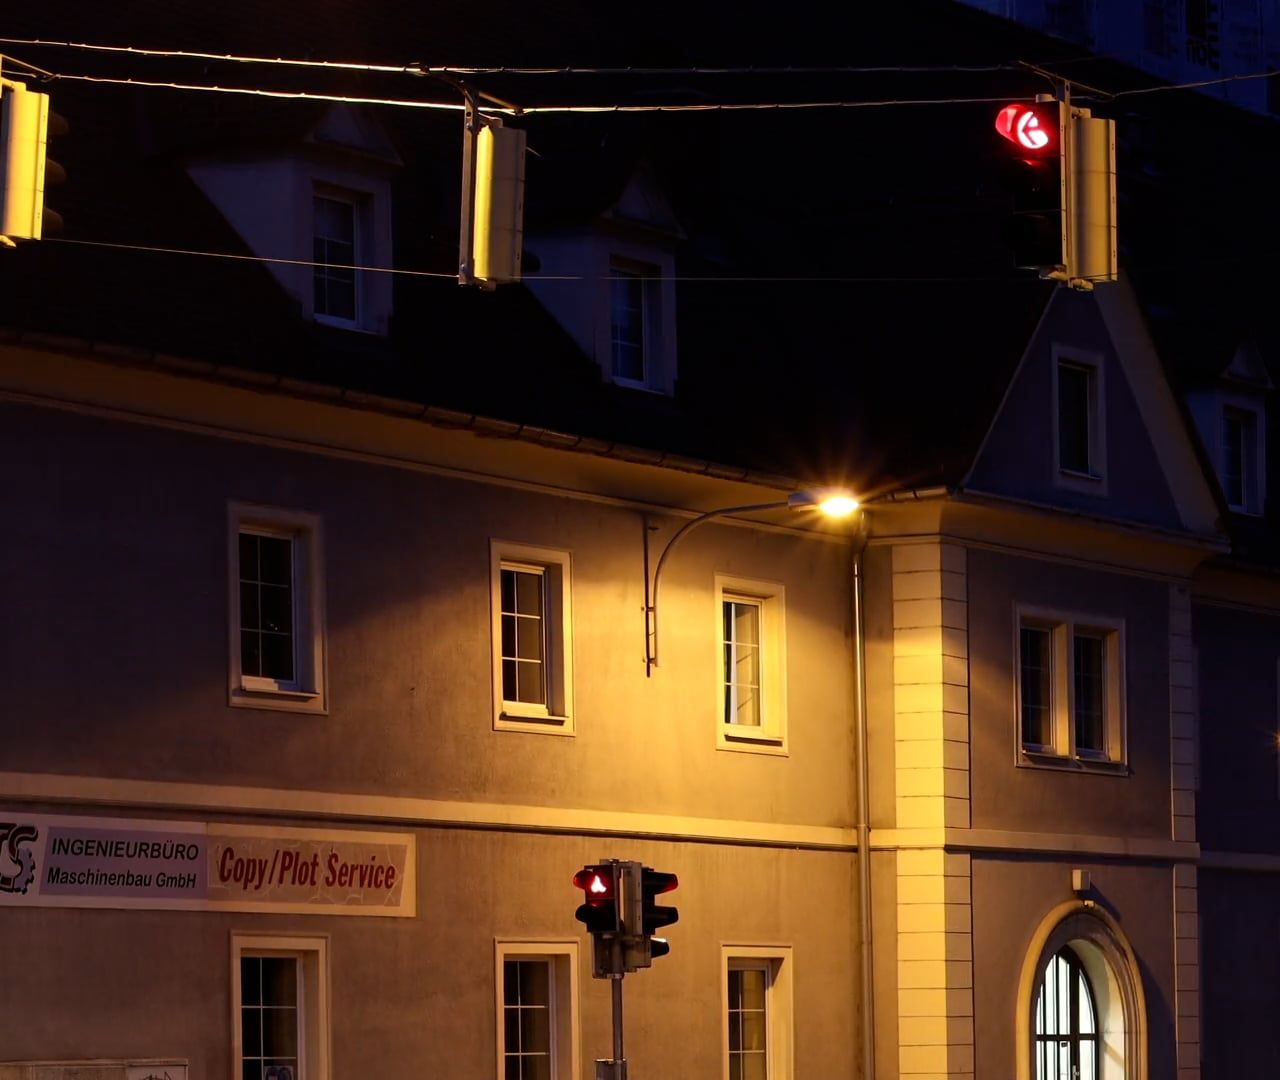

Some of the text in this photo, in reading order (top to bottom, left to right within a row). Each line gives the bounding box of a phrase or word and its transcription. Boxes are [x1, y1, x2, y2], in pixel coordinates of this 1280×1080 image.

[51, 837, 199, 861] INGENIEURBÜRO
[47, 867, 196, 889] Maschinenbau GmbH
[218, 847, 396, 891] Copy/Plot Service
